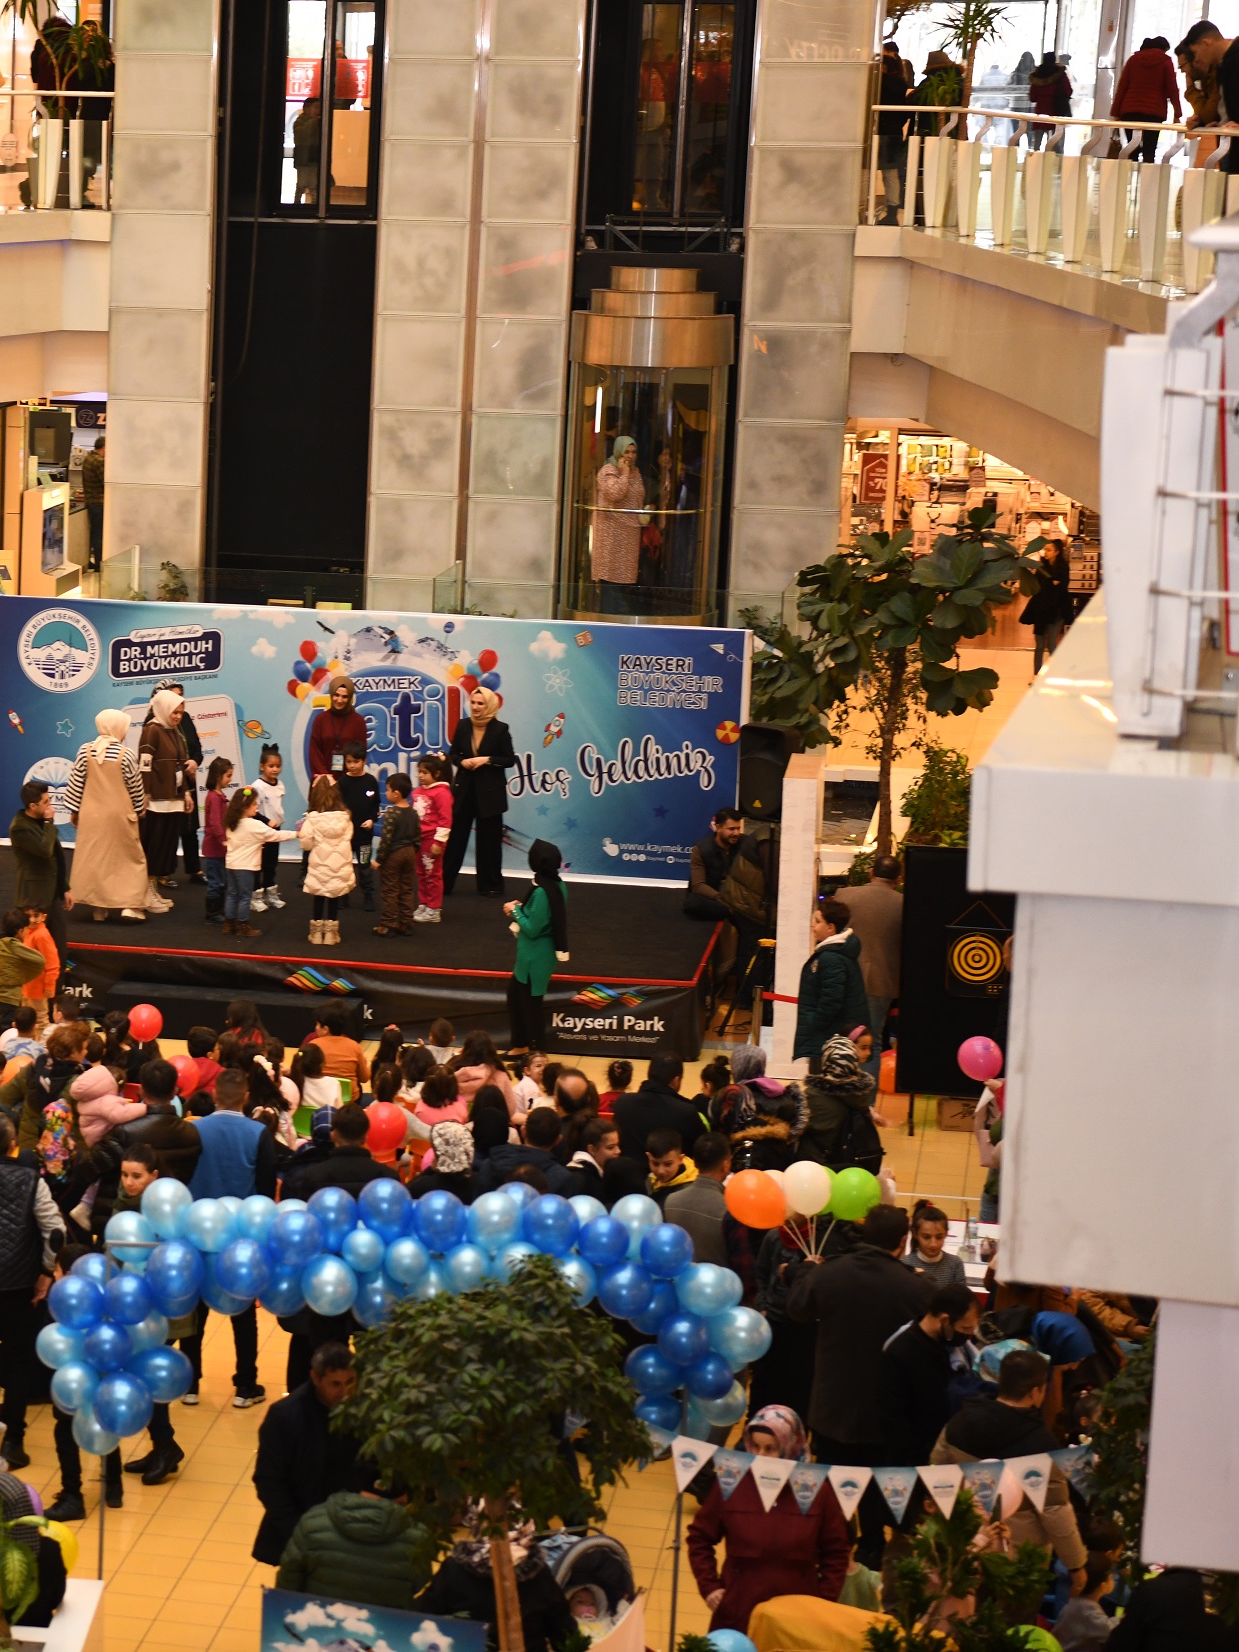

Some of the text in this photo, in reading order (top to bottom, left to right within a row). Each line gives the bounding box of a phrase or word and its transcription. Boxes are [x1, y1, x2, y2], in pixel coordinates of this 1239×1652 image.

[120, 640, 213, 660] DR. MEMDUH
[119, 654, 206, 674] BÜYÜKKILIÇ
[619, 654, 693, 673] KAYSERİ
[352, 675, 422, 692] KAYMEK
[618, 672, 724, 693] BÜYÜKŞEHİR
[617, 689, 709, 710] BELEDİYESİ
[506, 751, 572, 799] Hoş
[576, 734, 715, 797] Geldiniz
[62, 983, 94, 998] ark
[551, 1012, 665, 1033] Kayseri Park
